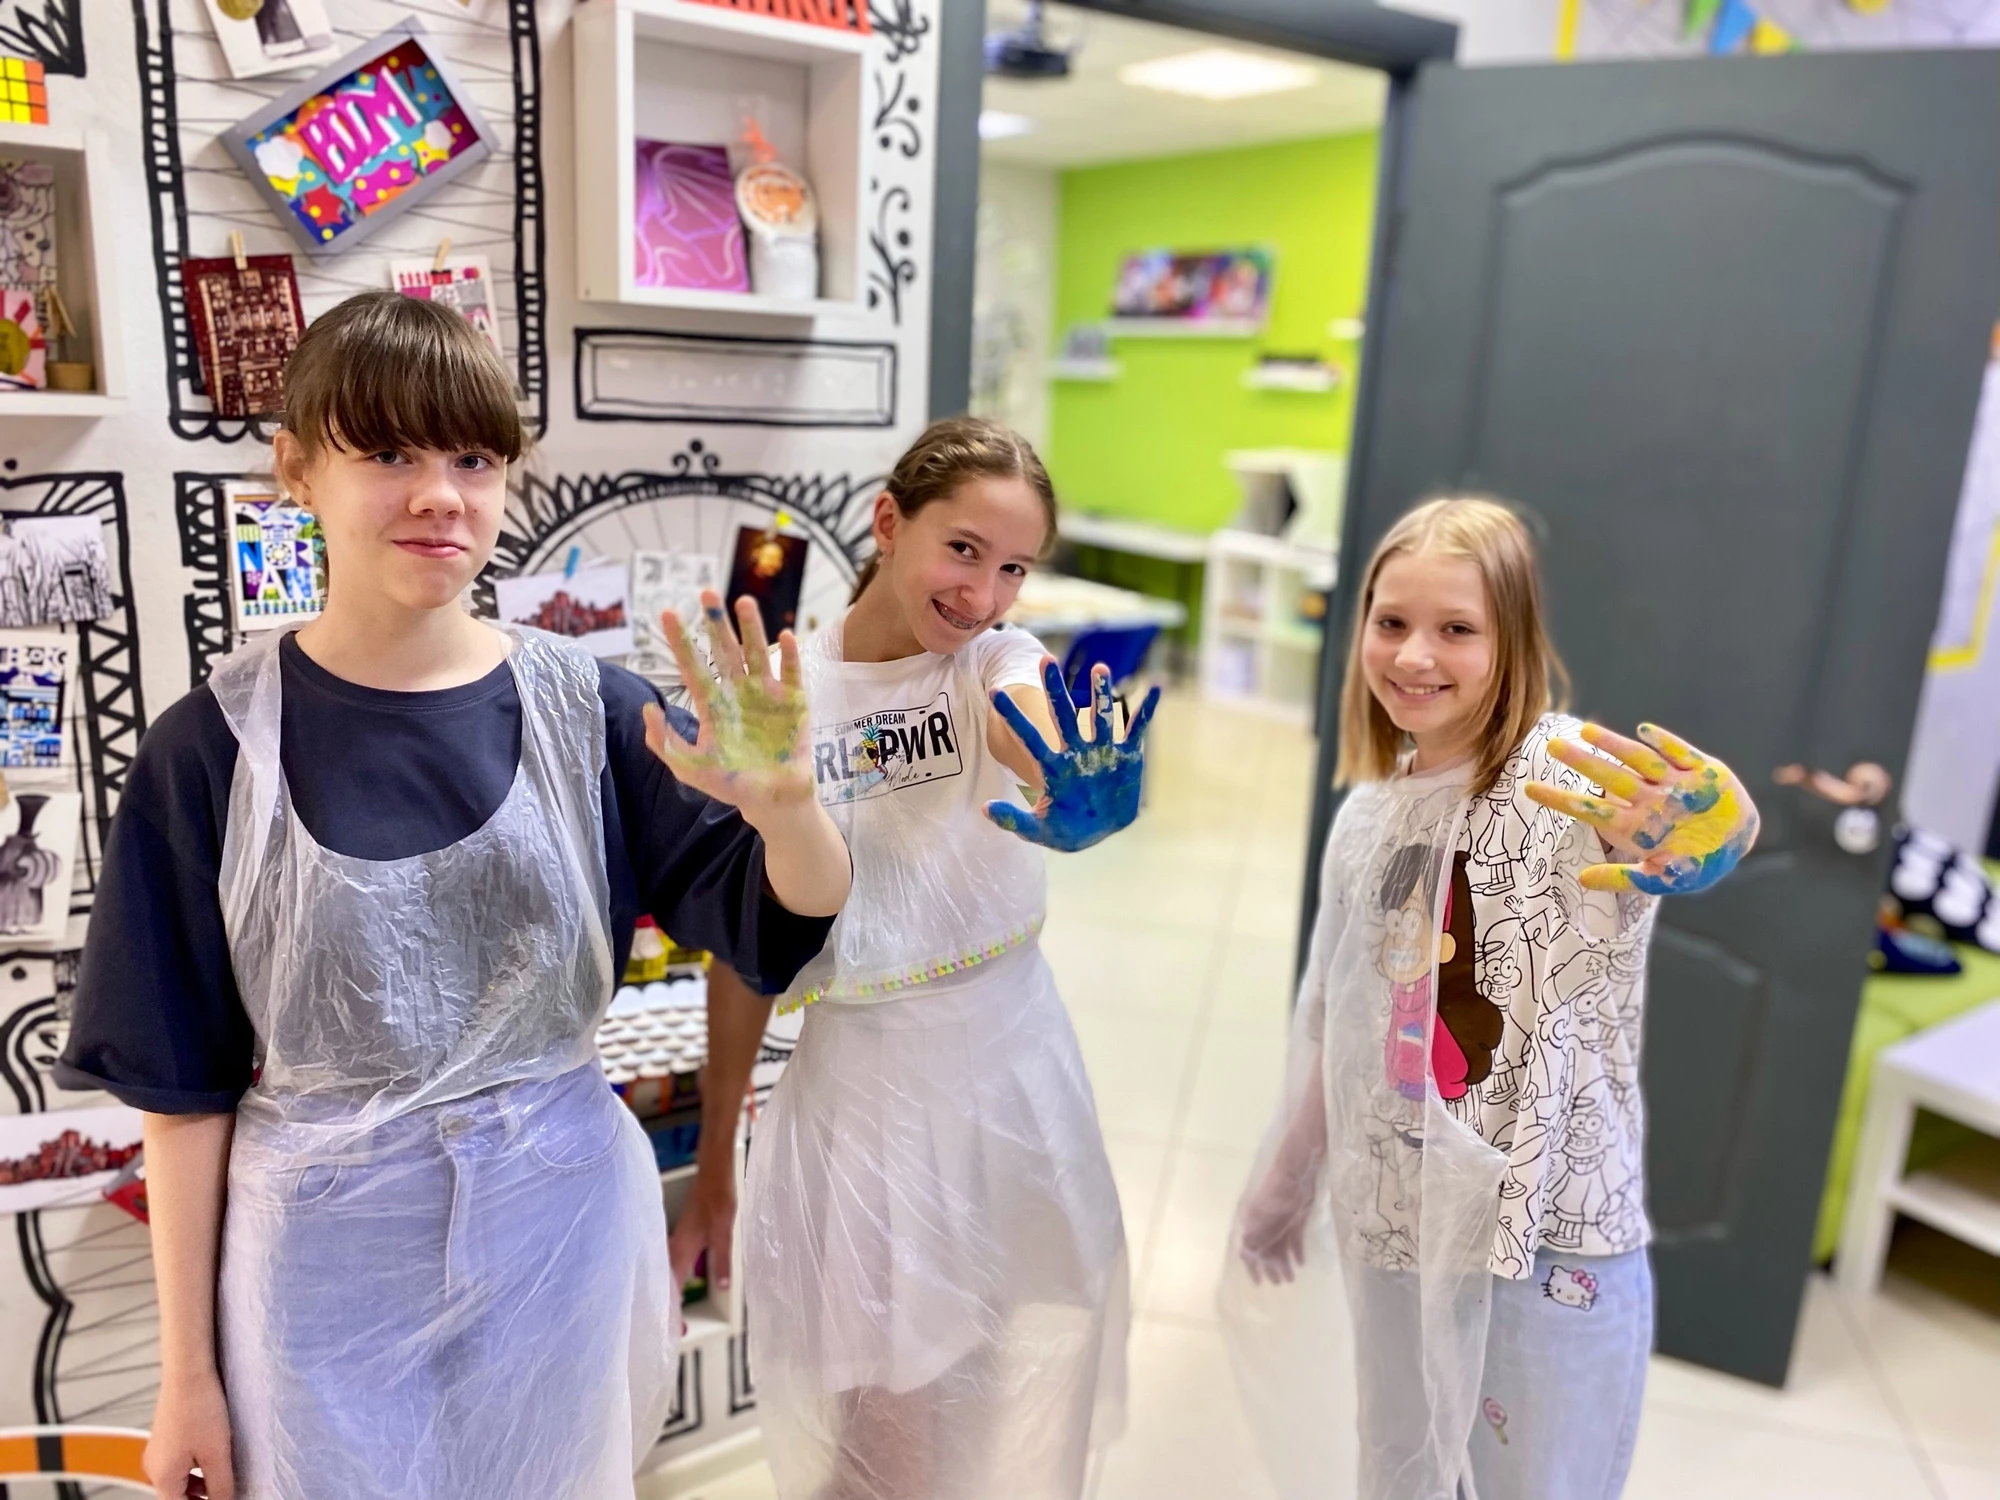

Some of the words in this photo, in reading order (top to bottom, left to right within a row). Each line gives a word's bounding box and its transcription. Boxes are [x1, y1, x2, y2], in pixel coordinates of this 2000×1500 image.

[815, 737, 861, 784] RL
[878, 711, 955, 765] PWR
[834, 717, 873, 736] SUMMER
[875, 713, 906, 726] DREAM
